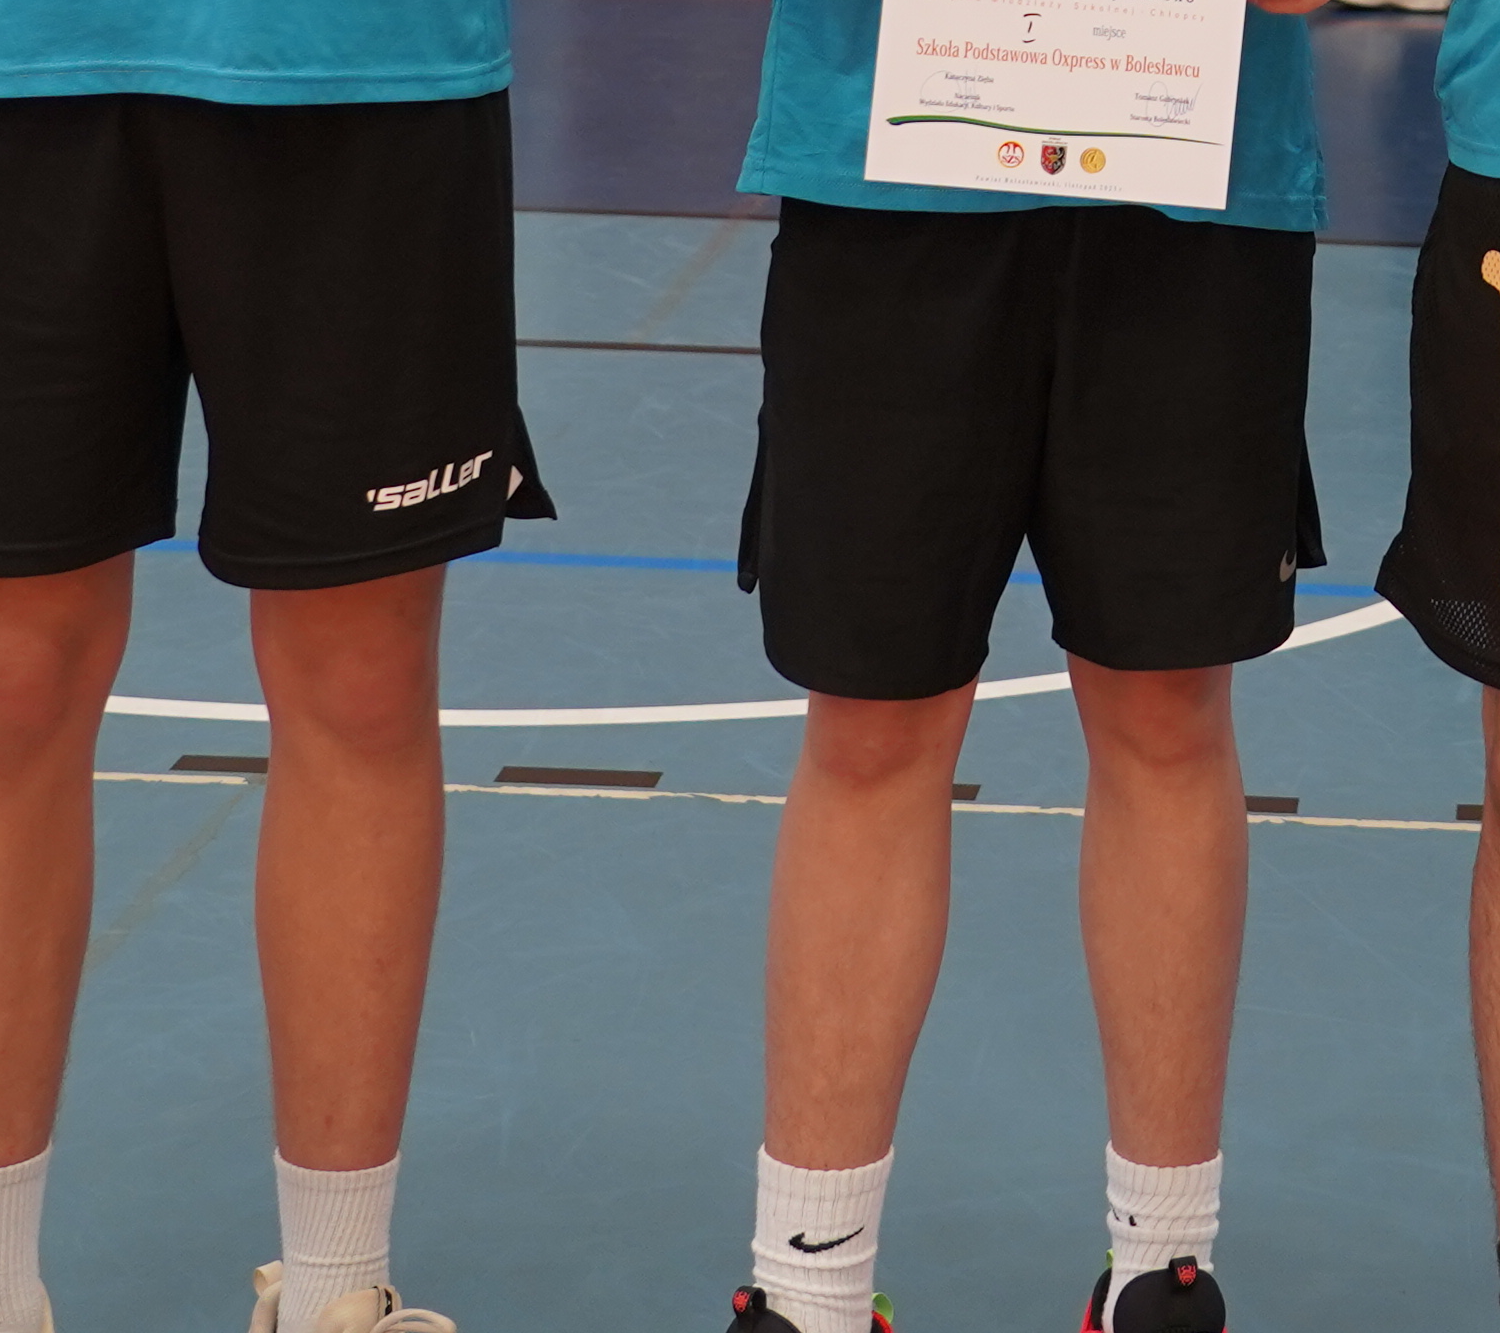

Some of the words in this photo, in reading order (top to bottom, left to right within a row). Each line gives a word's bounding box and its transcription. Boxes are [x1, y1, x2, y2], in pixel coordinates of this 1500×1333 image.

[1092, 24, 1127, 41] miejsce
[916, 37, 959, 58] Szkoła
[963, 40, 1047, 65] Podstawowa
[1052, 48, 1106, 72] Oxpress
[1110, 58, 1121, 71] w
[1125, 54, 1200, 79] Bolesławcu
